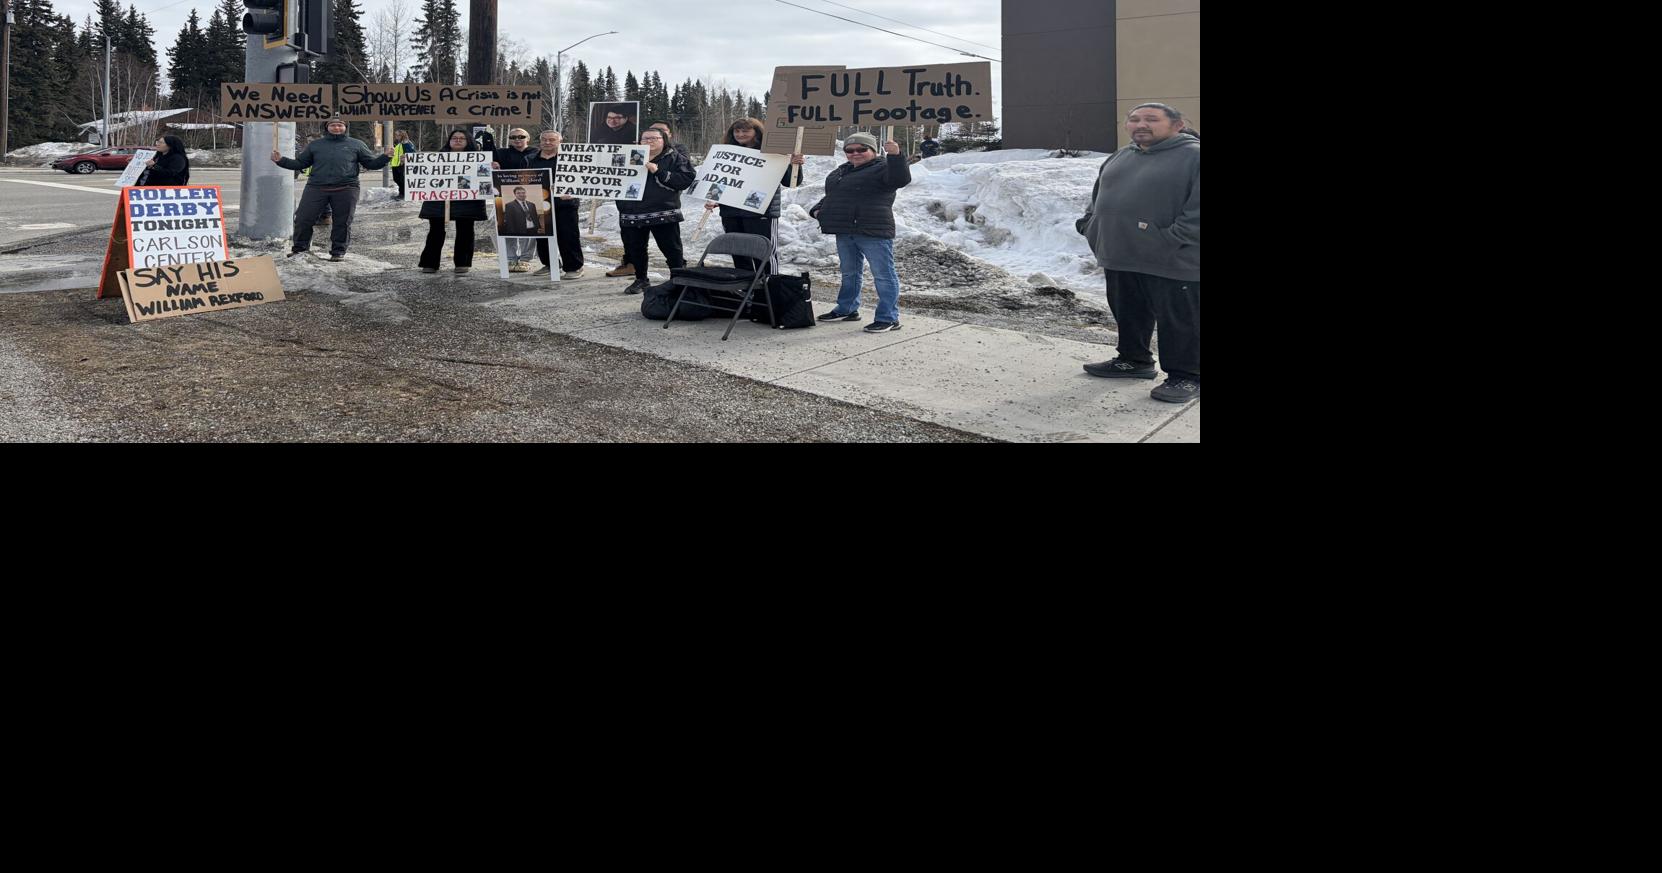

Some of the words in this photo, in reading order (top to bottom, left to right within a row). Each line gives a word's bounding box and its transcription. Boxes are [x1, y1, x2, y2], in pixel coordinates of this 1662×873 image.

[801, 70, 891, 100] FULL
[902, 68, 980, 98] Truth.
[226, 85, 260, 100] We
[271, 86, 322, 104] Need
[342, 84, 401, 104] Show
[405, 85, 431, 103] Us
[440, 87, 453, 100] A
[455, 88, 499, 100] Crisis
[506, 90, 518, 99] is
[521, 91, 542, 100] not
[227, 103, 331, 119] ANSWERS
[340, 104, 373, 115] WHAT
[447, 106, 458, 115] a
[788, 104, 842, 123] FULL
[853, 99, 981, 124] Footage.
[560, 143, 605, 153] WHAT
[607, 144, 622, 153] IF
[406, 153, 424, 163] WE
[427, 152, 486, 162] CALLED
[558, 153, 593, 163] THIS
[712, 151, 766, 168] JUSTICE
[406, 165, 429, 175] FOR
[431, 165, 471, 175] HELP
[556, 164, 638, 177] HAPPENED
[712, 162, 742, 175] FOR
[407, 178, 426, 188] WE
[430, 178, 454, 188] GOT
[556, 175, 575, 183] TO
[581, 176, 622, 186] YOUR
[702, 173, 744, 189] ADAM
[128, 188, 217, 200] ROLLER
[409, 190, 479, 200] TRAGEDY
[555, 186, 622, 198] FAMILY?
[130, 202, 219, 217] DERBY
[131, 218, 222, 231] TONIGHT
[133, 235, 222, 252] CARLSON
[134, 265, 184, 287] SAY
[197, 261, 240, 281] HIS
[166, 282, 219, 297] NAME
[135, 297, 205, 316] WILLIAM
[208, 292, 264, 306] REXFORD
